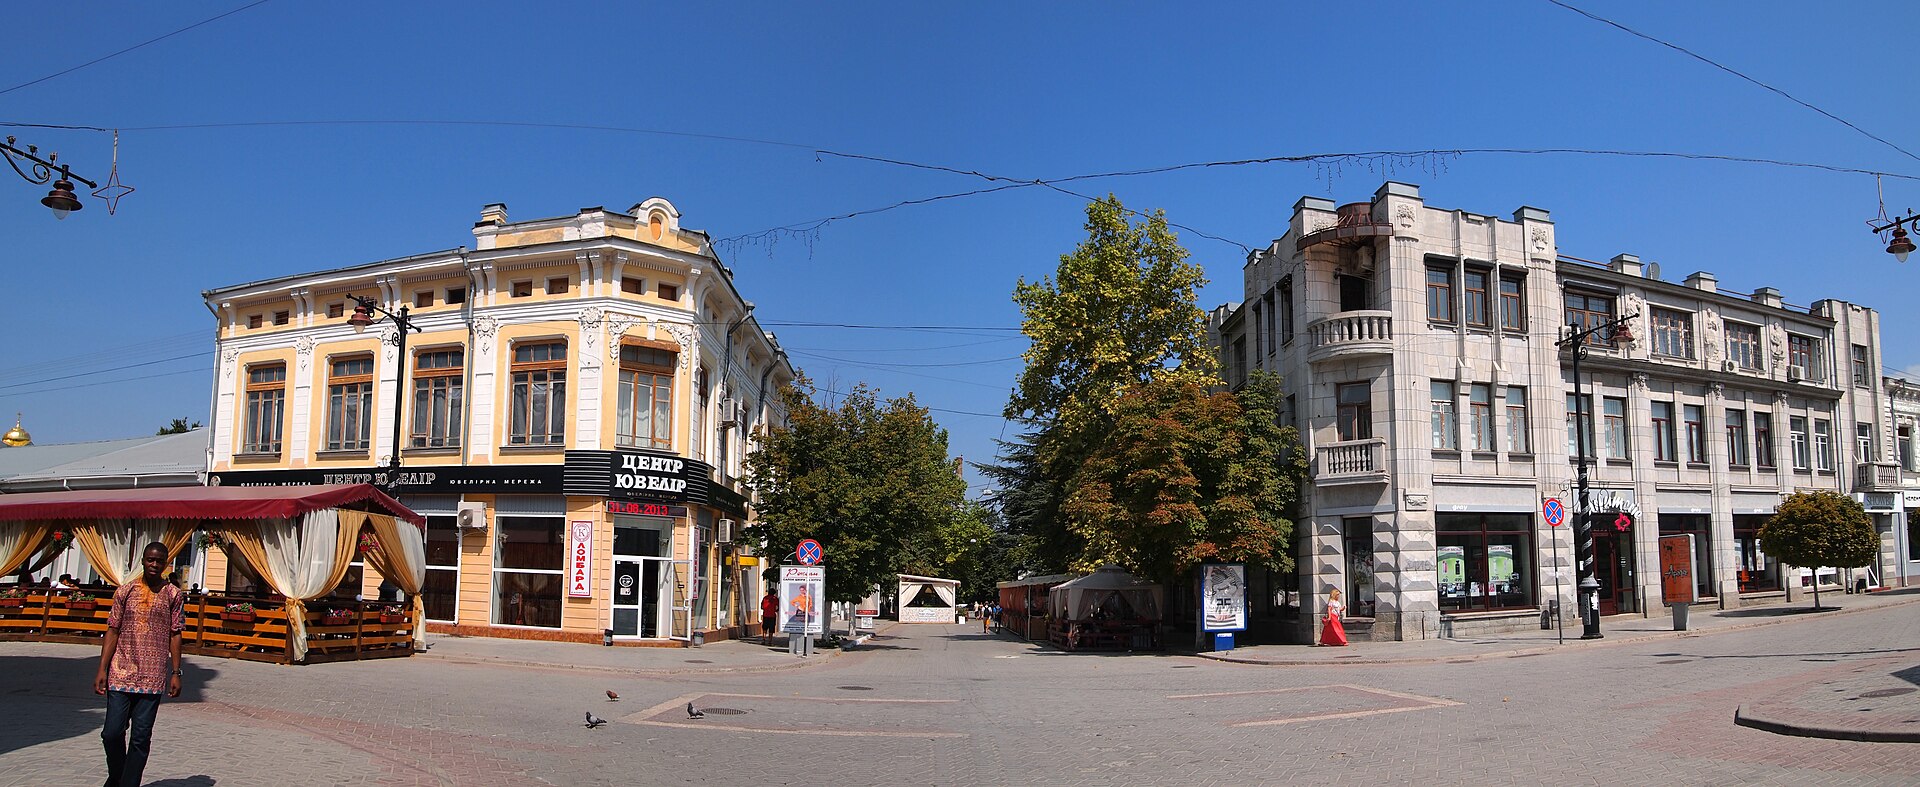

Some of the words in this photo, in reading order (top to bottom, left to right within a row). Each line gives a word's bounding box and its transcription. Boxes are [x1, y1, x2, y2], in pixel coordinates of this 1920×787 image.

[621, 454, 684, 474] ЦЕНТР
[323, 473, 372, 486] ЦЕНТР
[374, 472, 436, 486] ЮЕЛІР
[614, 473, 687, 493] ЮВЕЛІР
